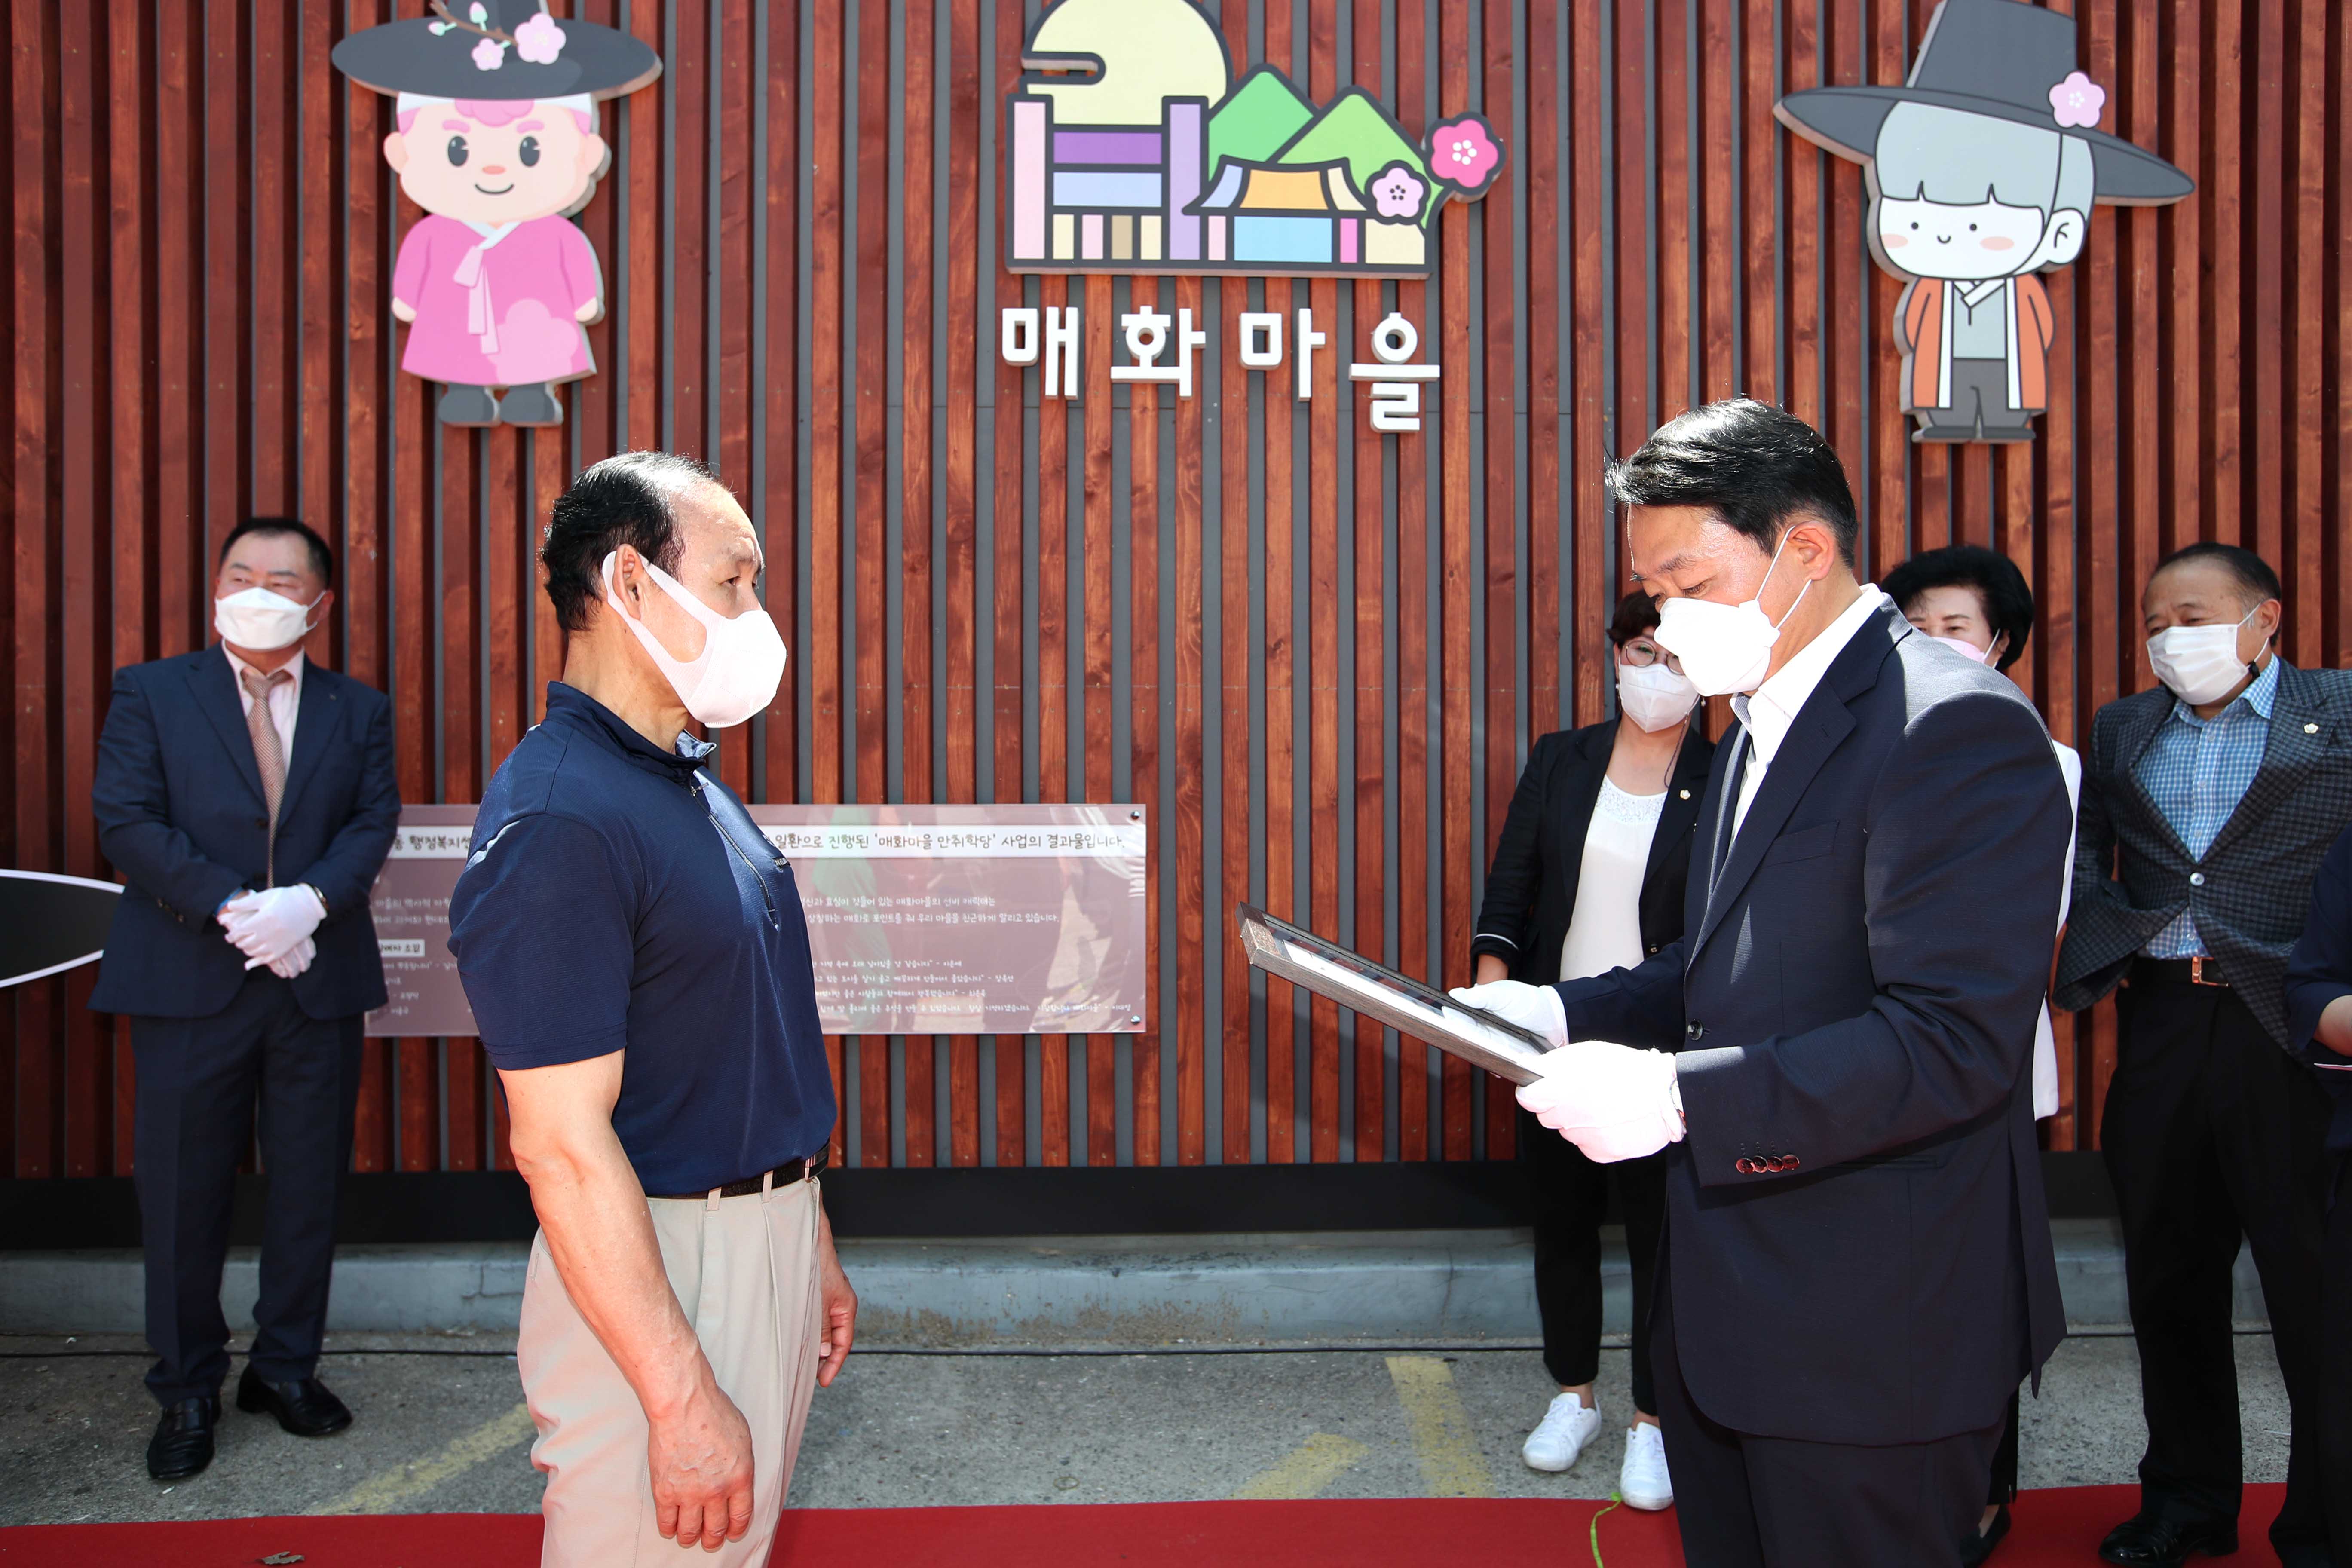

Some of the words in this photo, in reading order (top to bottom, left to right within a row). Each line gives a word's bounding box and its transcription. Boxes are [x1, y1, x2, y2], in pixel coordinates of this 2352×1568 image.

[1002, 306, 1440, 433] 매화마을
[775, 833, 823, 849] 일환으로
[829, 834, 869, 849] 진행된
[1001, 833, 1041, 848] 사업의
[1047, 833, 1125, 850] 결과물입니다.
[878, 896, 894, 908] 있는
